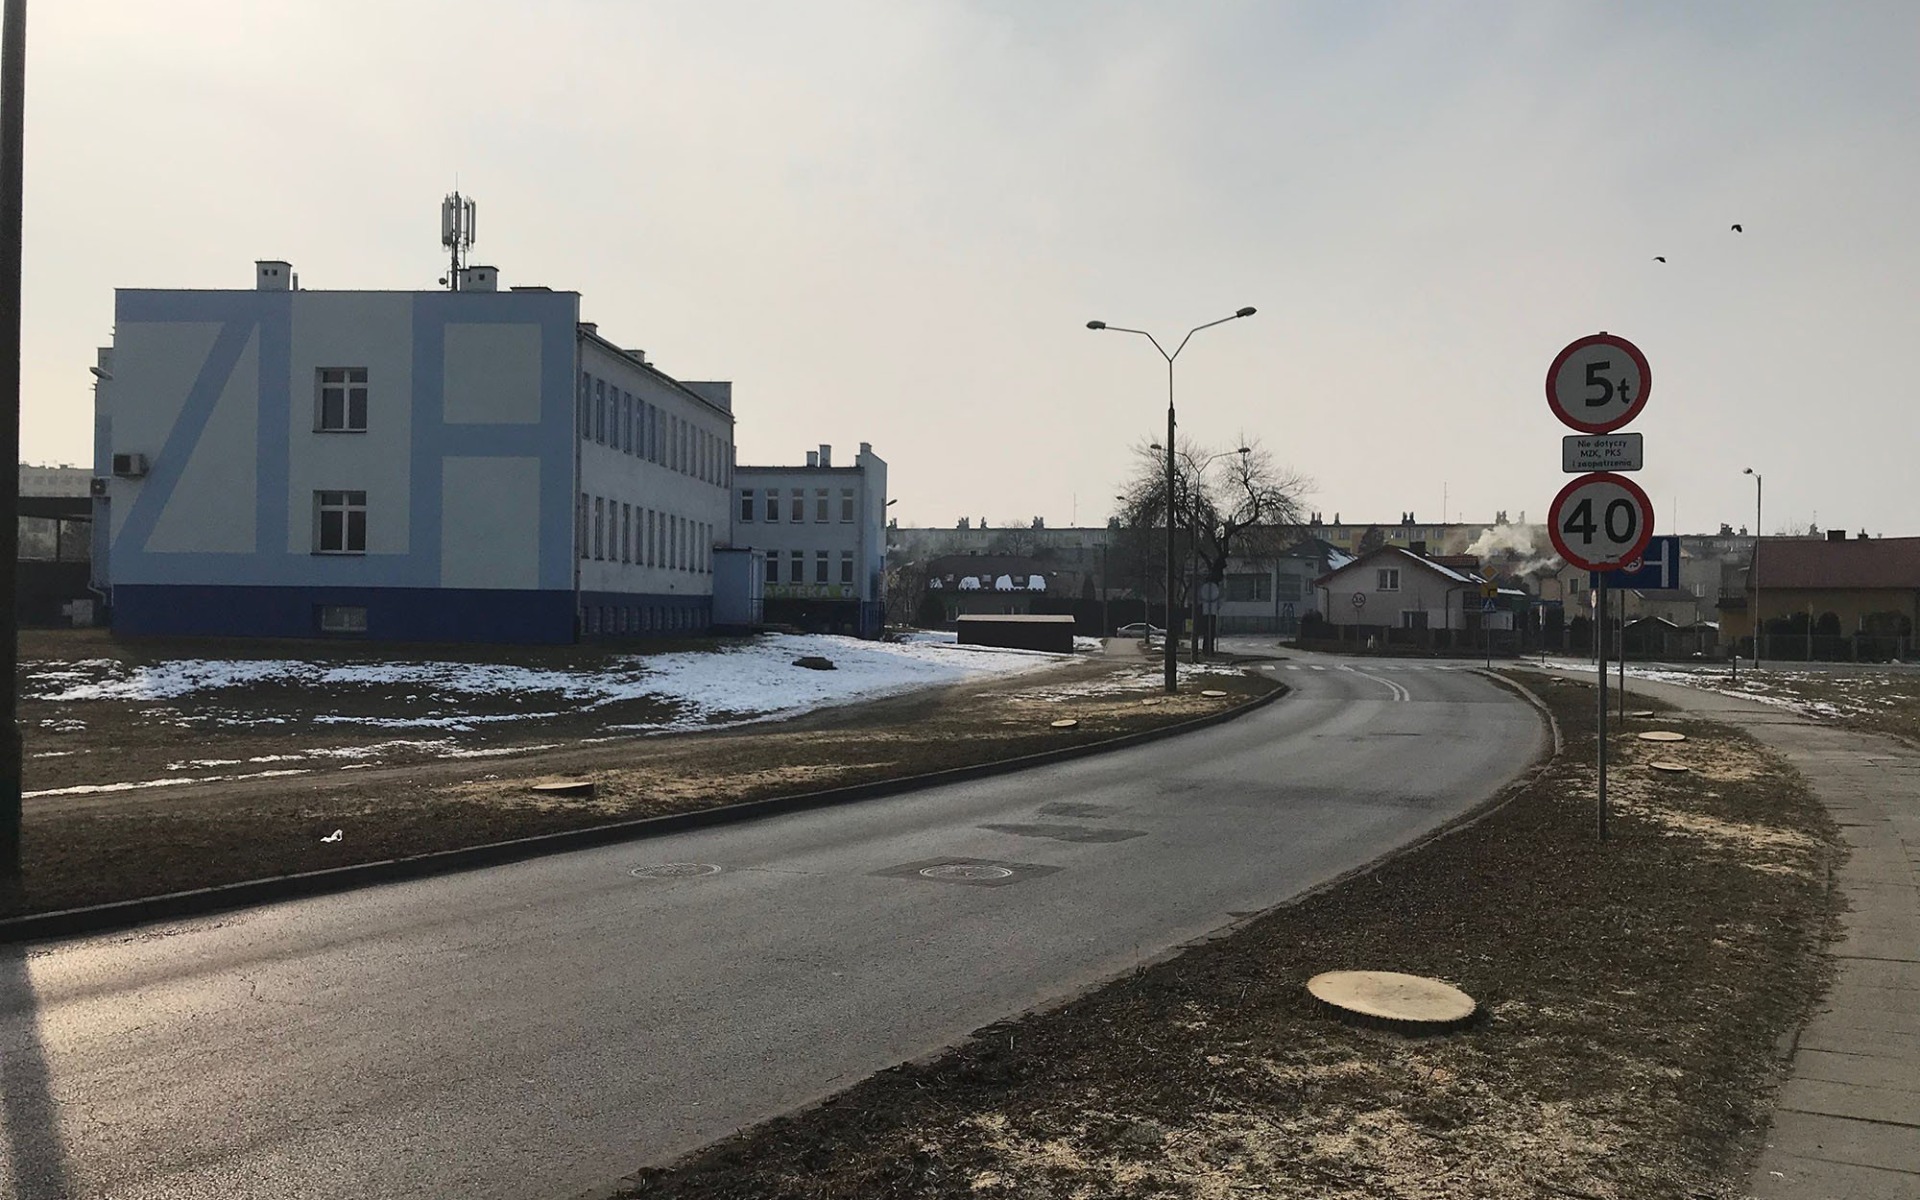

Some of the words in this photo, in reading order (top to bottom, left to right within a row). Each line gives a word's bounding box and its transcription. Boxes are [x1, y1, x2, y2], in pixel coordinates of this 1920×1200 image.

[1578, 440, 1591, 448] Nie
[1594, 440, 1627, 448] dotyczy
[1580, 449, 1602, 458] MZK,
[1605, 449, 1622, 457] PKS
[1563, 498, 1636, 545] 40
[764, 585, 830, 599] APTEKA
